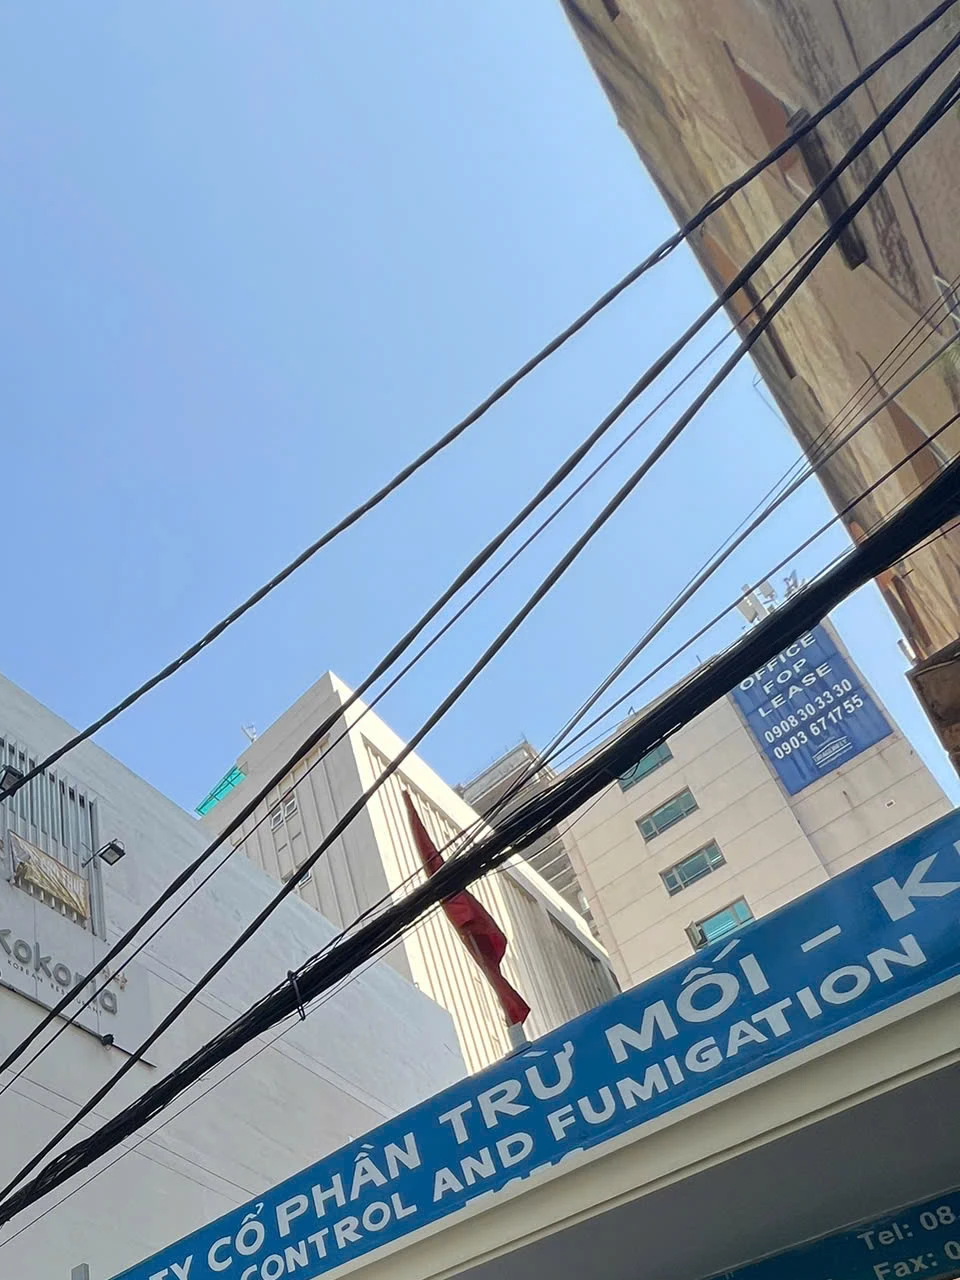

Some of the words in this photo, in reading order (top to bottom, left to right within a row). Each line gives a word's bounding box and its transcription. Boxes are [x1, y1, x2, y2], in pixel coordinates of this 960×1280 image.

[740, 633, 816, 690] OFFICE
[758, 662, 832, 717] LEASE
[764, 715, 798, 743] 0908
[797, 703, 816, 721] 30
[815, 691, 834, 709] 33
[833, 679, 852, 697] 30
[774, 731, 808, 759] 0903
[843, 695, 864, 713] 55
[7, 959, 43, 983] KOREAN
[207, 1202, 264, 1272] CỔ
[275, 1132, 421, 1238] PHẦN
[439, 1040, 574, 1144] TRỪ
[605, 939, 769, 1063] MỐI
[872, 838, 960, 922] K
[433, 1132, 534, 1202] AND
[547, 934, 927, 1141] FUMIGATION
[857, 1222, 914, 1251] Tel:
[920, 1206, 959, 1230] 08
